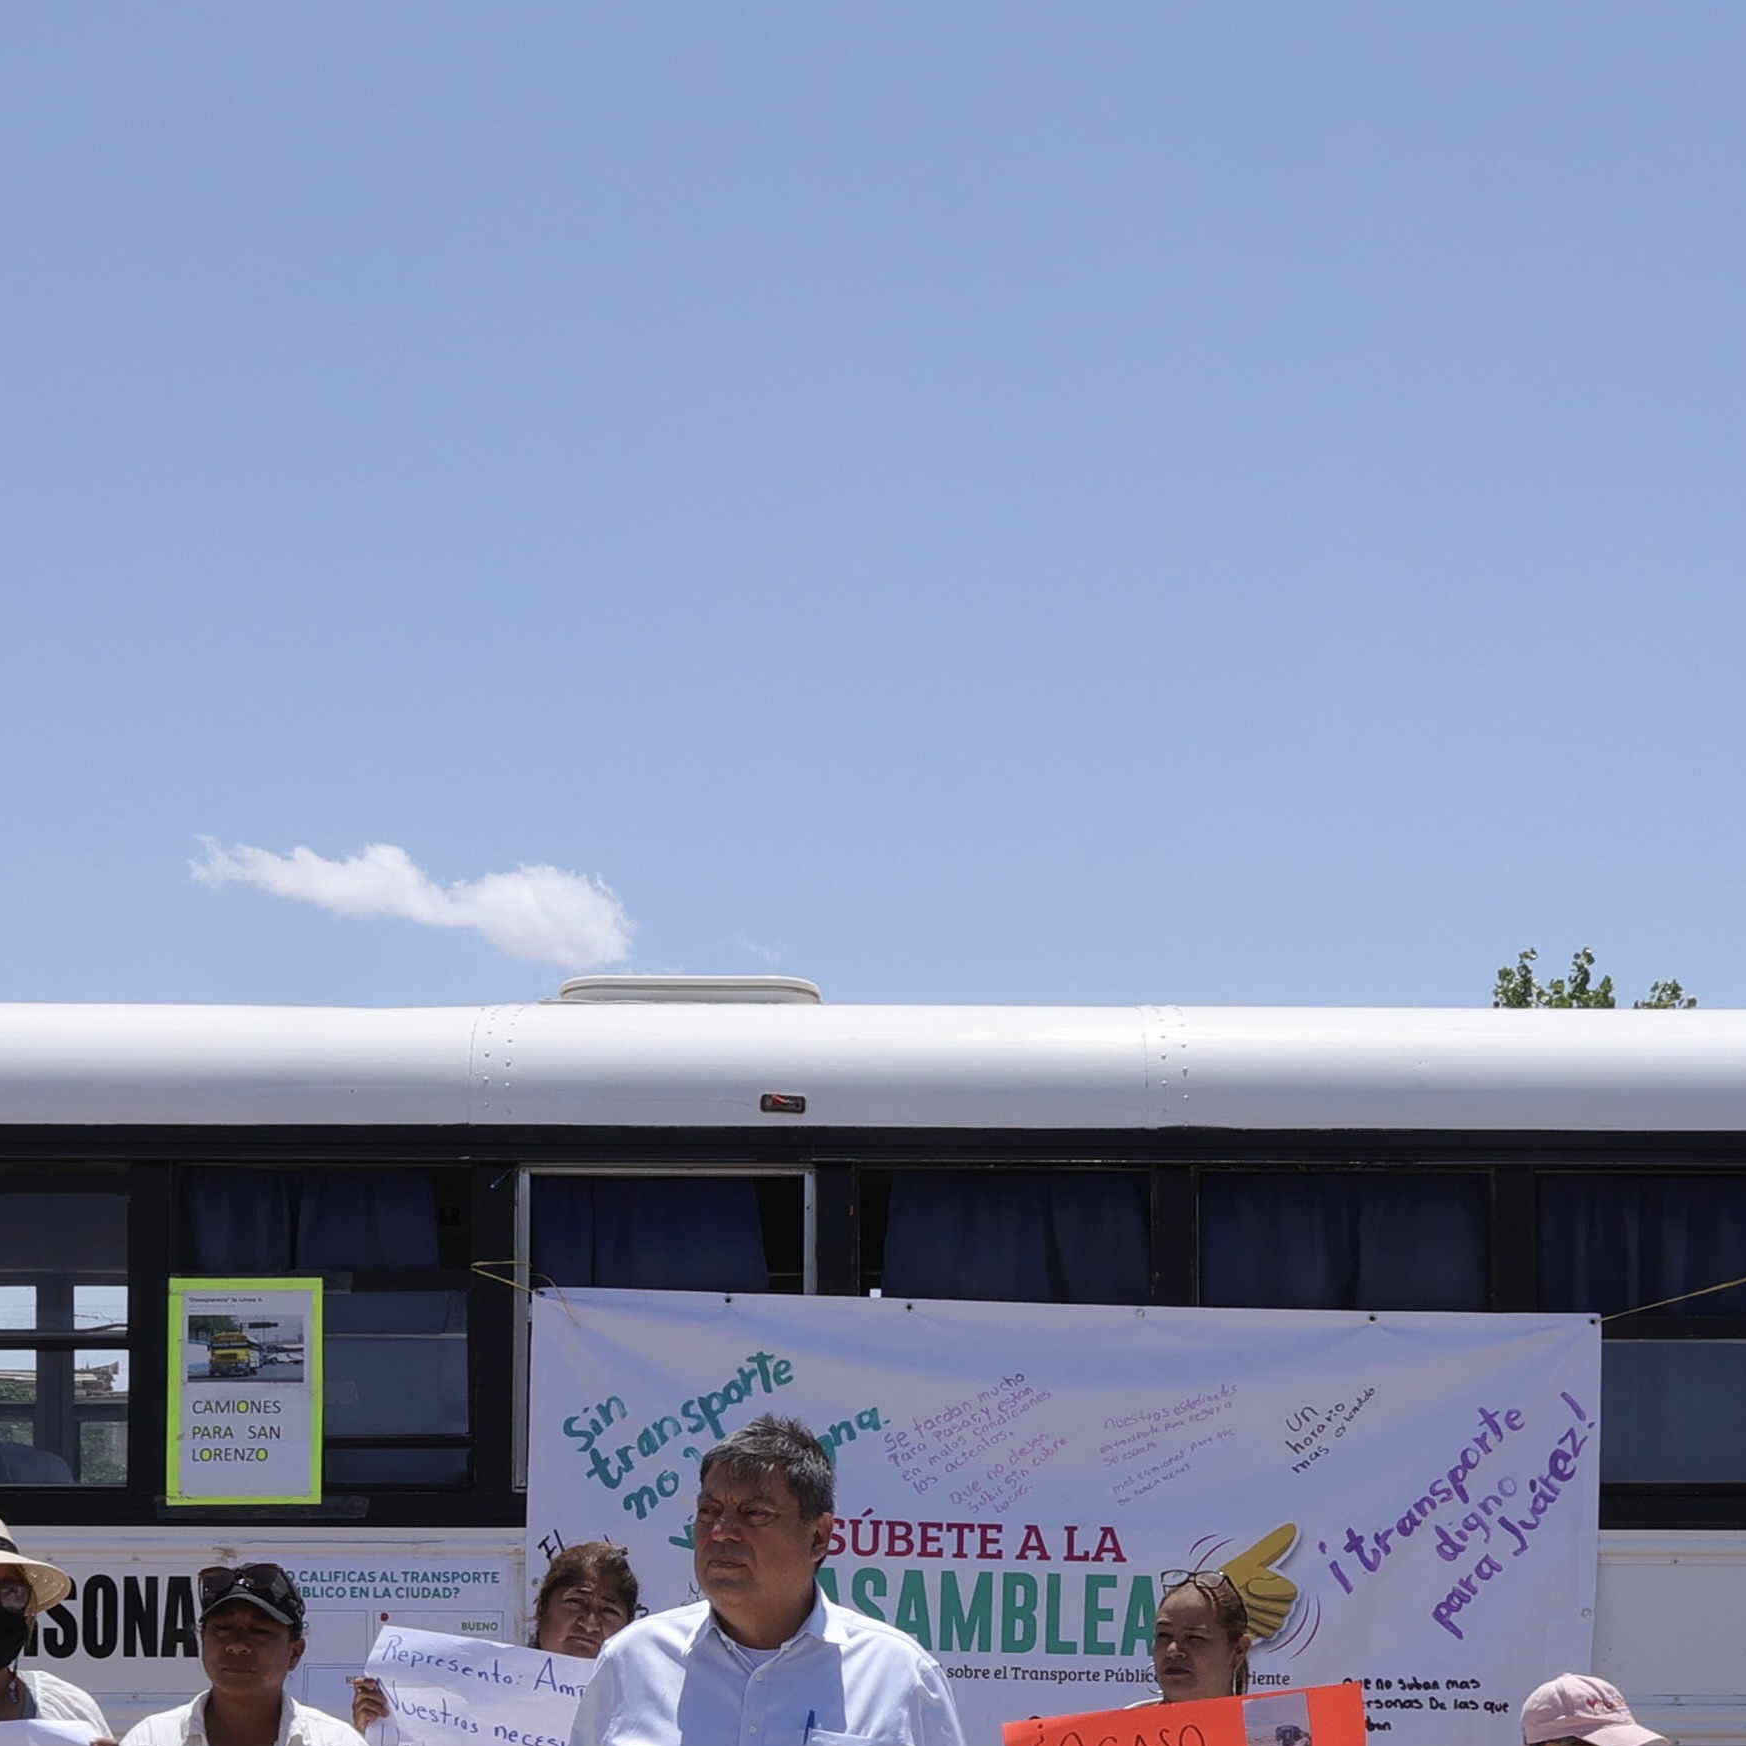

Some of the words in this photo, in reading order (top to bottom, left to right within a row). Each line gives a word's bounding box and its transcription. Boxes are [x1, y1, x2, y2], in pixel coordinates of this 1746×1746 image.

[192, 1400, 281, 1414] CAMIONES
[585, 1351, 794, 1490] transporte
[913, 1401, 972, 1438] tardan
[978, 1373, 1025, 1402] mucho
[192, 1425, 234, 1440] PARA
[248, 1425, 281, 1440] SAN
[563, 1394, 628, 1453] Sin
[1285, 1403, 1345, 1454] horario
[192, 1447, 268, 1462] LORENZO
[1291, 1445, 1329, 1474] mas
[623, 1470, 679, 1520] no
[1435, 1476, 1518, 1562] digno
[1015, 1524, 1051, 1561] A
[1063, 1526, 1127, 1563] LA
[299, 1570, 377, 1584] CALIFICAS
[380, 1571, 398, 1583] AL
[402, 1571, 500, 1584] TRANSPORTE
[350, 1587, 369, 1599] EN
[373, 1587, 391, 1599] LA
[395, 1586, 461, 1599] CIUDAD?
[816, 1566, 1155, 1657] SAMBLEA
[1431, 1556, 1502, 1641] para
[461, 1621, 499, 1631] BUENO
[946, 1665, 990, 1680] sobre
[994, 1665, 1008, 1680] el
[1011, 1666, 1101, 1685] Transporte
[1376, 1677, 1393, 1691] no
[1398, 1676, 1441, 1691] suban
[1446, 1678, 1481, 1690] mas
[376, 1677, 479, 1734] Nuestras
[1454, 1699, 1479, 1711] las
[1484, 1701, 1510, 1714] que
